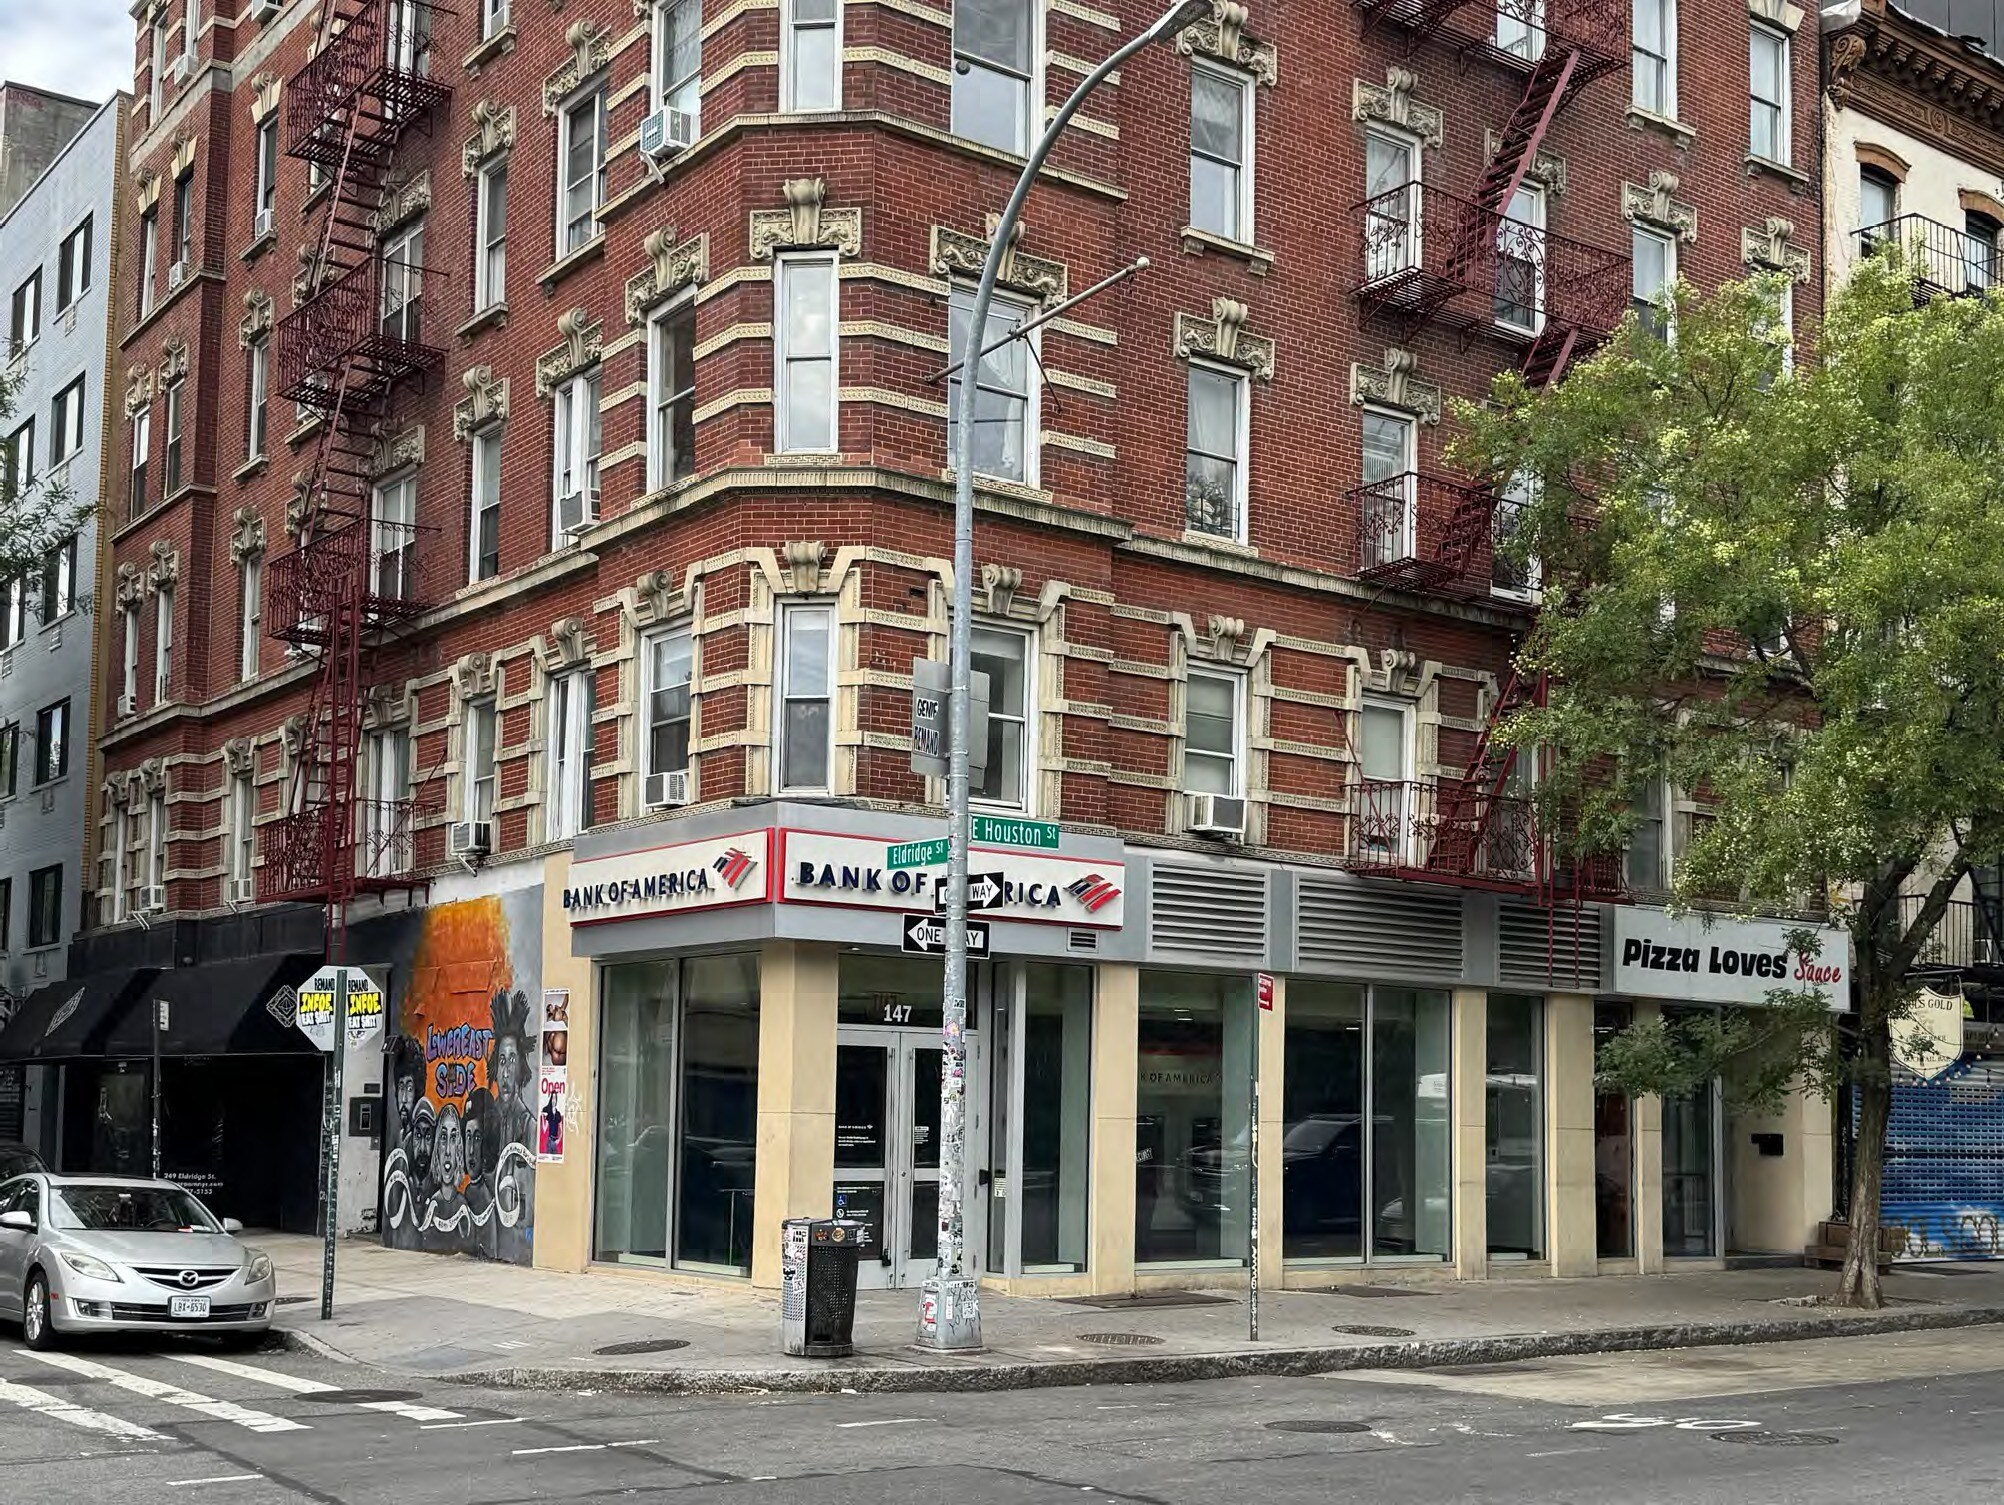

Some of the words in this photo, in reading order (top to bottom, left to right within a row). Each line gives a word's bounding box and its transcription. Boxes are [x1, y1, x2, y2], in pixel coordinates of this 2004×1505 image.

[972, 818, 978, 839] E
[985, 819, 1041, 846] Houston
[1046, 826, 1056, 840] St
[893, 843, 933, 866] Eldridge
[935, 841, 944, 854] St
[800, 861, 882, 890] BANK
[892, 870, 928, 894] OF
[1004, 881, 1061, 906] RICA
[971, 884, 993, 900] WAY
[563, 883, 604, 908] BANK
[916, 927, 941, 943] ONE
[1622, 938, 1700, 972] Pizza
[1708, 946, 1788, 979] Loves
[1794, 950, 1841, 983] Sauce
[883, 1004, 912, 1022] 147
[1928, 999, 1953, 1010] GOLD
[541, 1077, 566, 1095] Open
